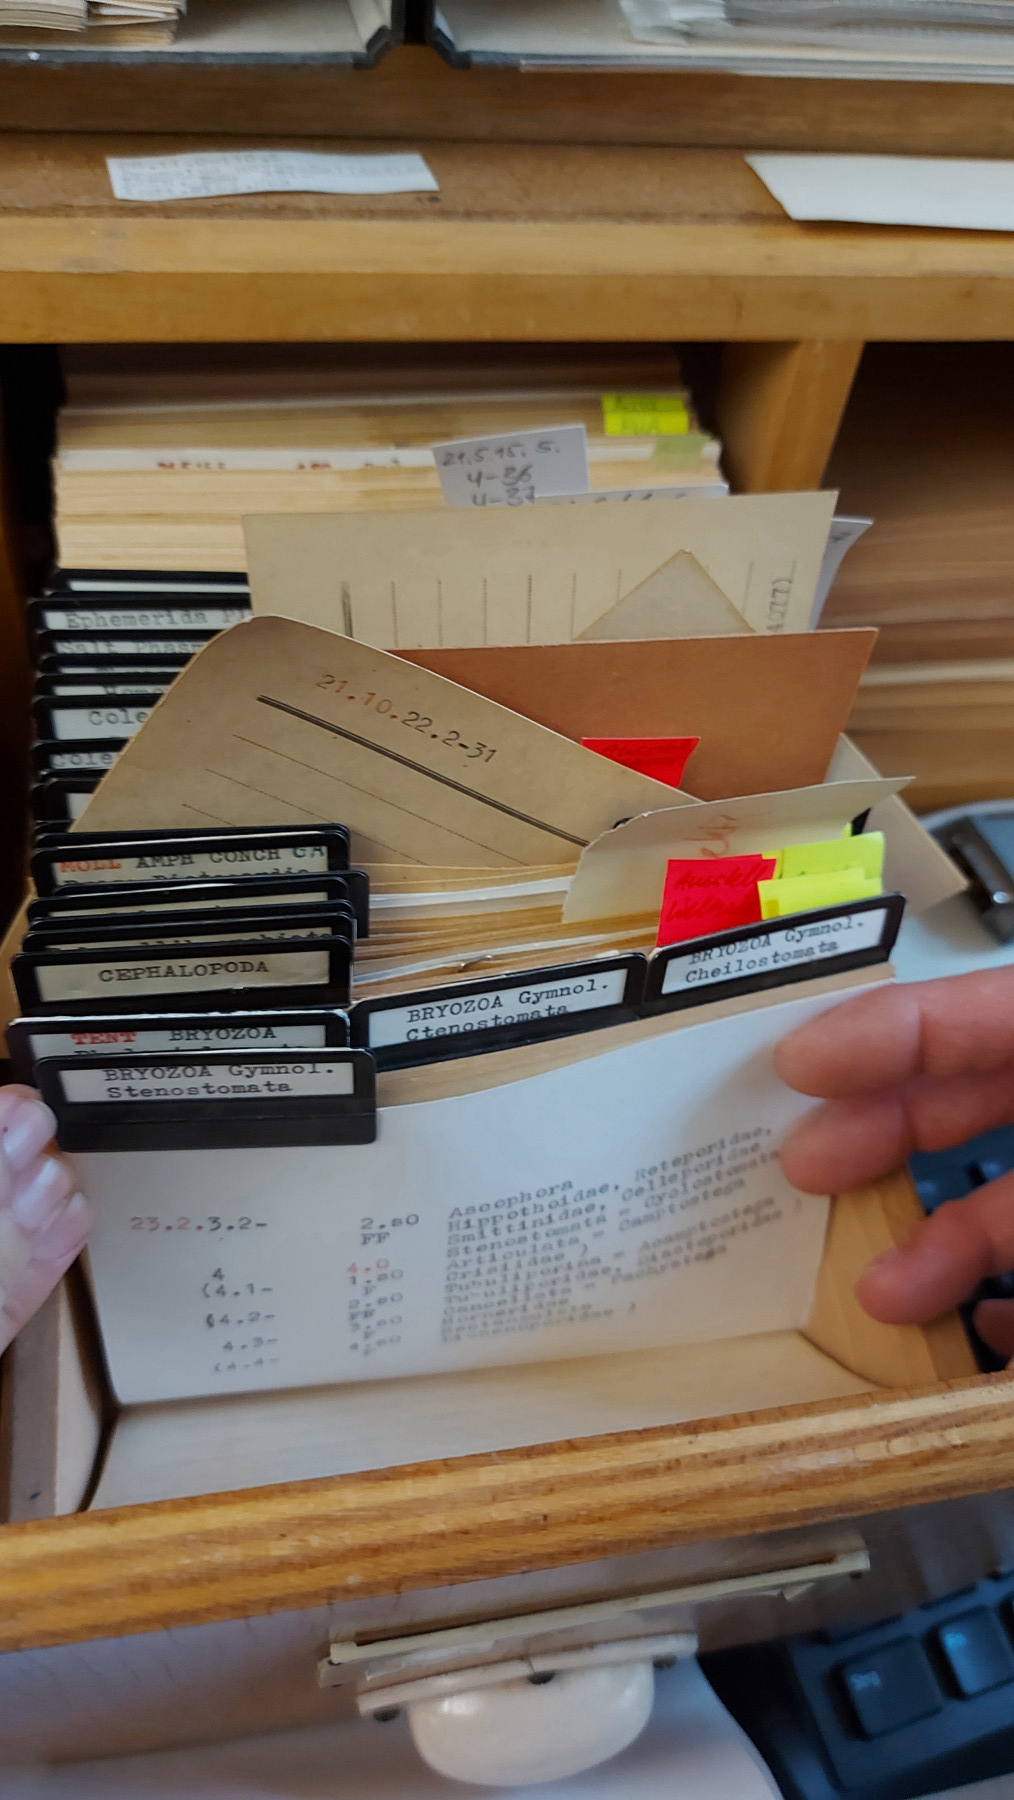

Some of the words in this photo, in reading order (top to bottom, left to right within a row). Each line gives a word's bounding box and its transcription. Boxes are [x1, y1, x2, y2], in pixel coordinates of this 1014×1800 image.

[65, 611, 209, 631] Ephemerida
[221, 610, 254, 625] Pl
[88, 710, 149, 726] Cole
[315, 673, 497, 763] 21.10.22.2-31
[53, 752, 114, 767] Cole
[135, 854, 195, 869] AMPH
[210, 849, 281, 865] CONCH
[688, 933, 772, 966] BRYOZOA
[784, 915, 865, 943] Gymnol.
[99, 960, 270, 983] CEPHALOPODA
[684, 939, 839, 984] Cheilostomata
[407, 994, 504, 1024] BRYOZOA
[518, 978, 609, 1006] Gymnol.
[405, 1003, 570, 1043] Ctenostomata
[70, 1031, 137, 1046] TENT
[168, 1026, 278, 1042] BRYOZOA
[103, 1065, 213, 1083] BRYOZOA
[227, 1062, 335, 1080] Gymnol.
[107, 1080, 293, 1100] Stenostomata
[129, 1215, 268, 1232] 23.2.3.2-
[449, 1180, 574, 1219] Ascophora
[448, 1183, 620, 1233] Hippothoidae,
[211, 1266, 226, 1281] 4
